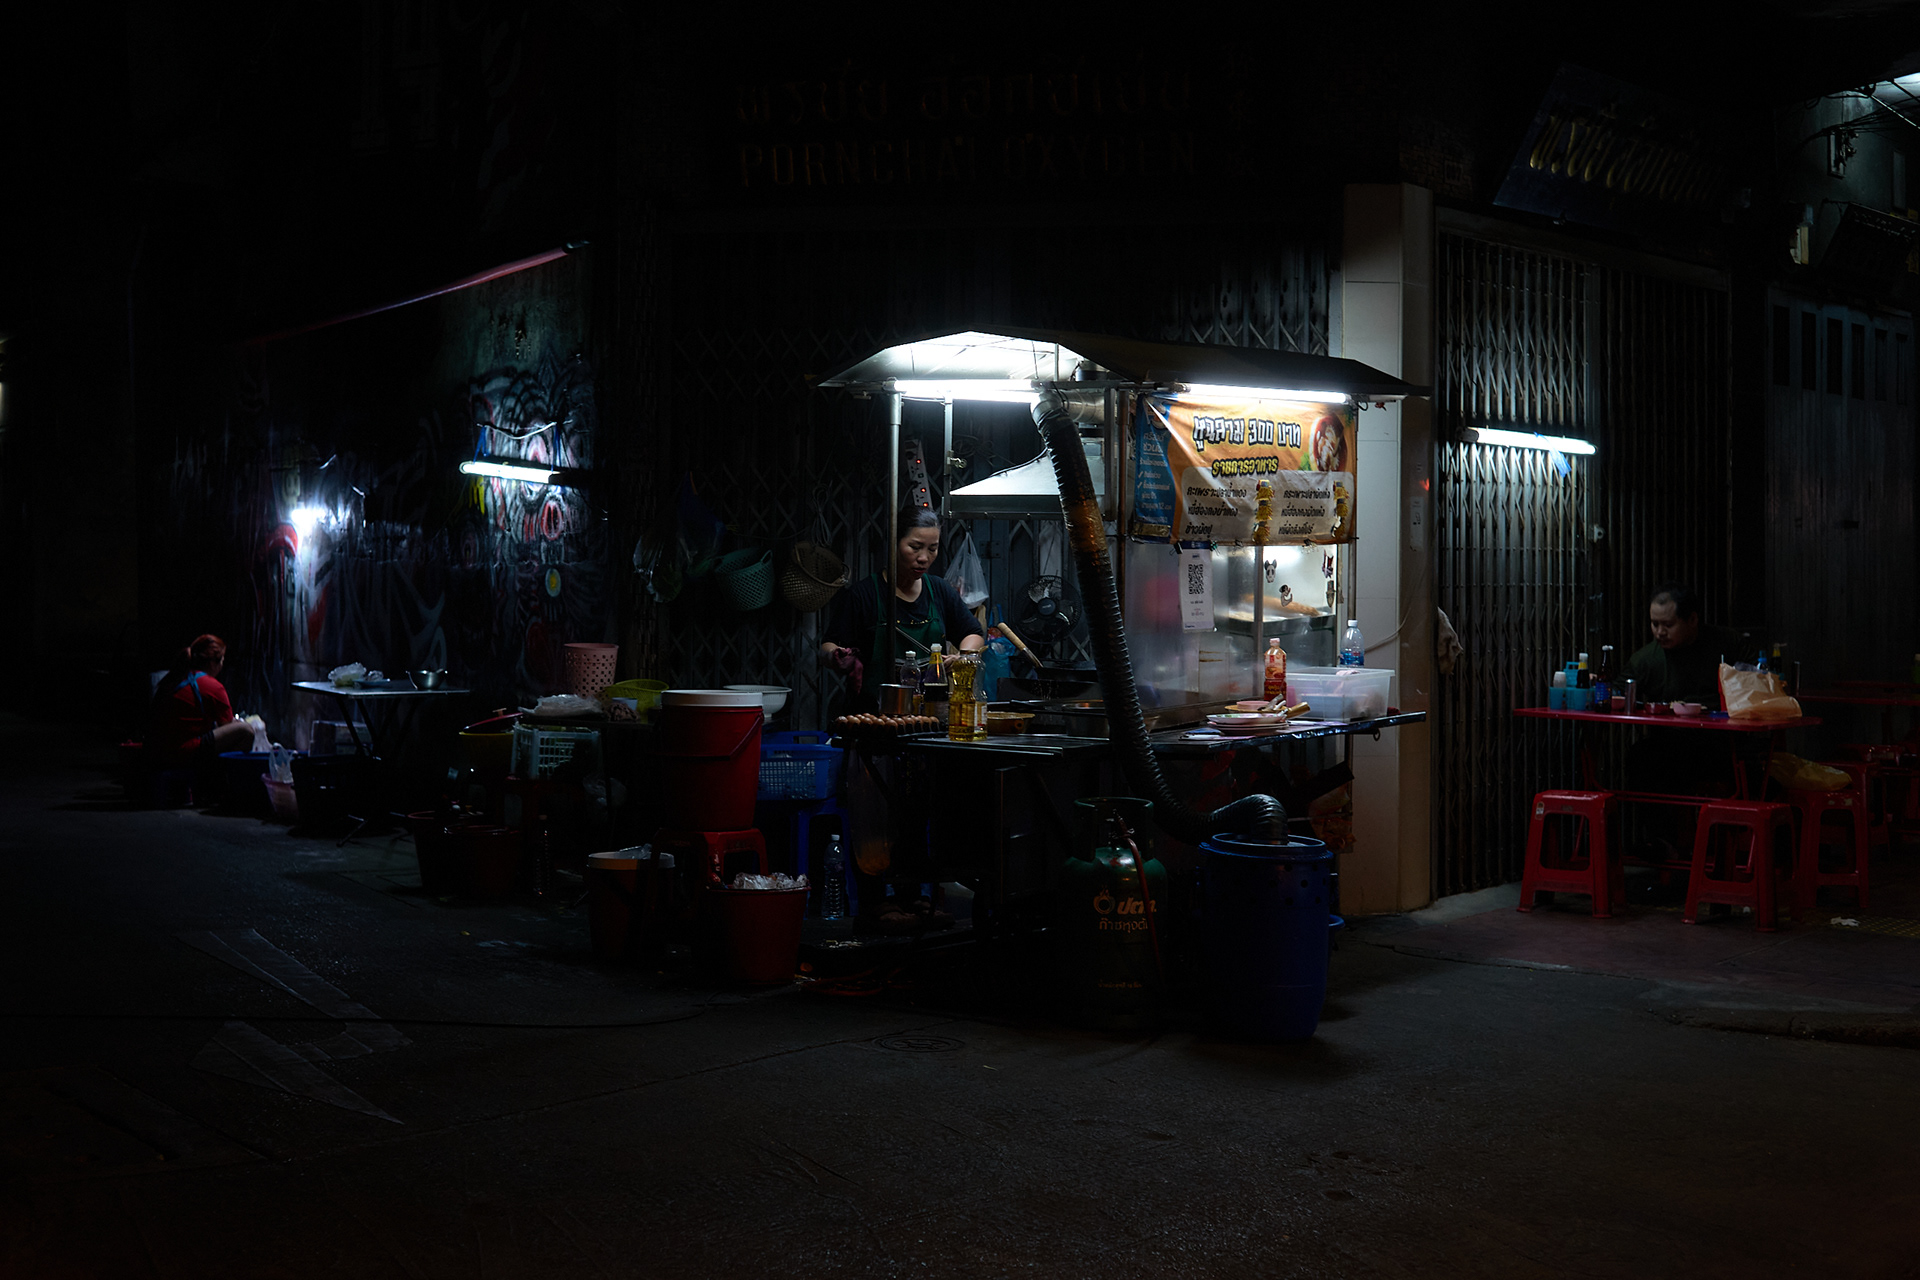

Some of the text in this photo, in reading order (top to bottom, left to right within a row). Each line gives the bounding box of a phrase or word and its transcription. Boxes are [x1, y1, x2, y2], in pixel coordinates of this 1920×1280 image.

[739, 132, 1195, 187] PORNCHAI OXYGEN
[1193, 415, 1301, 452] หูฉลาม 300 บาท
[1212, 456, 1279, 477] รายการอาหาร
[1099, 917, 1149, 934] ก๊าซหุงต้
